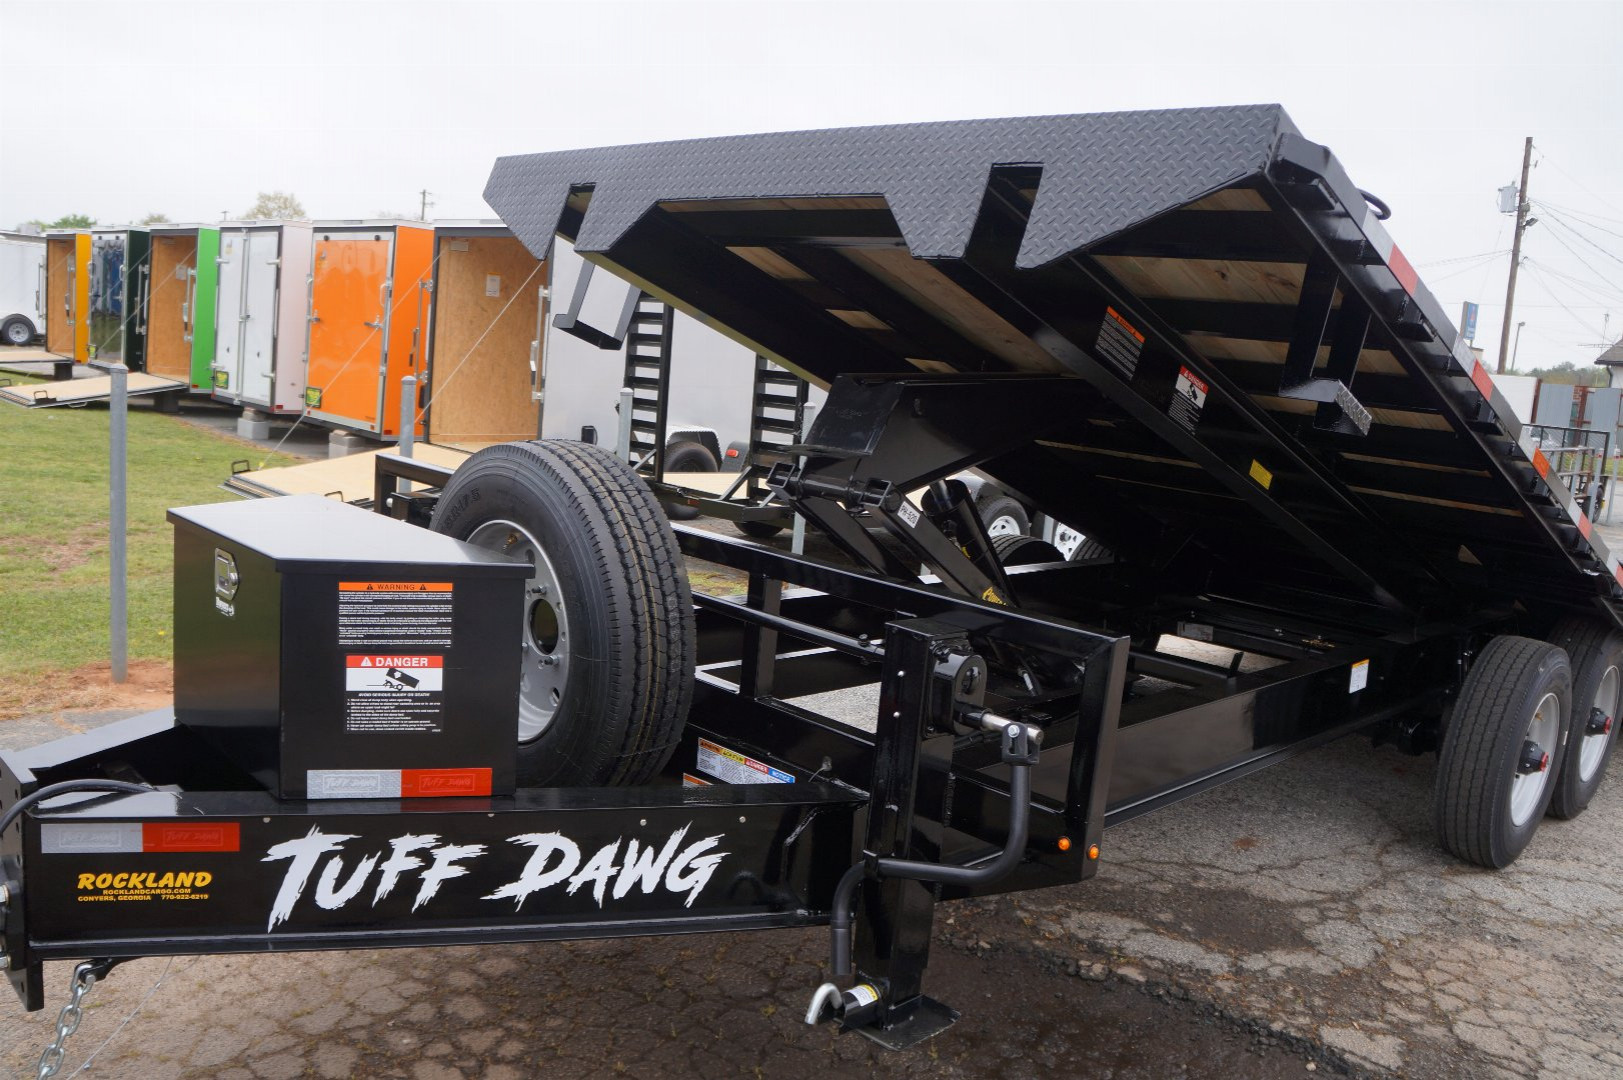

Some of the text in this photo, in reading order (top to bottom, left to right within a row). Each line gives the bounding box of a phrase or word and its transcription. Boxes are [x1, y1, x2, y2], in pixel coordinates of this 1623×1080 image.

[375, 657, 428, 667] DANGER
[77, 872, 212, 890] ROCKLAND
[260, 821, 731, 933] TUFF DAWG
